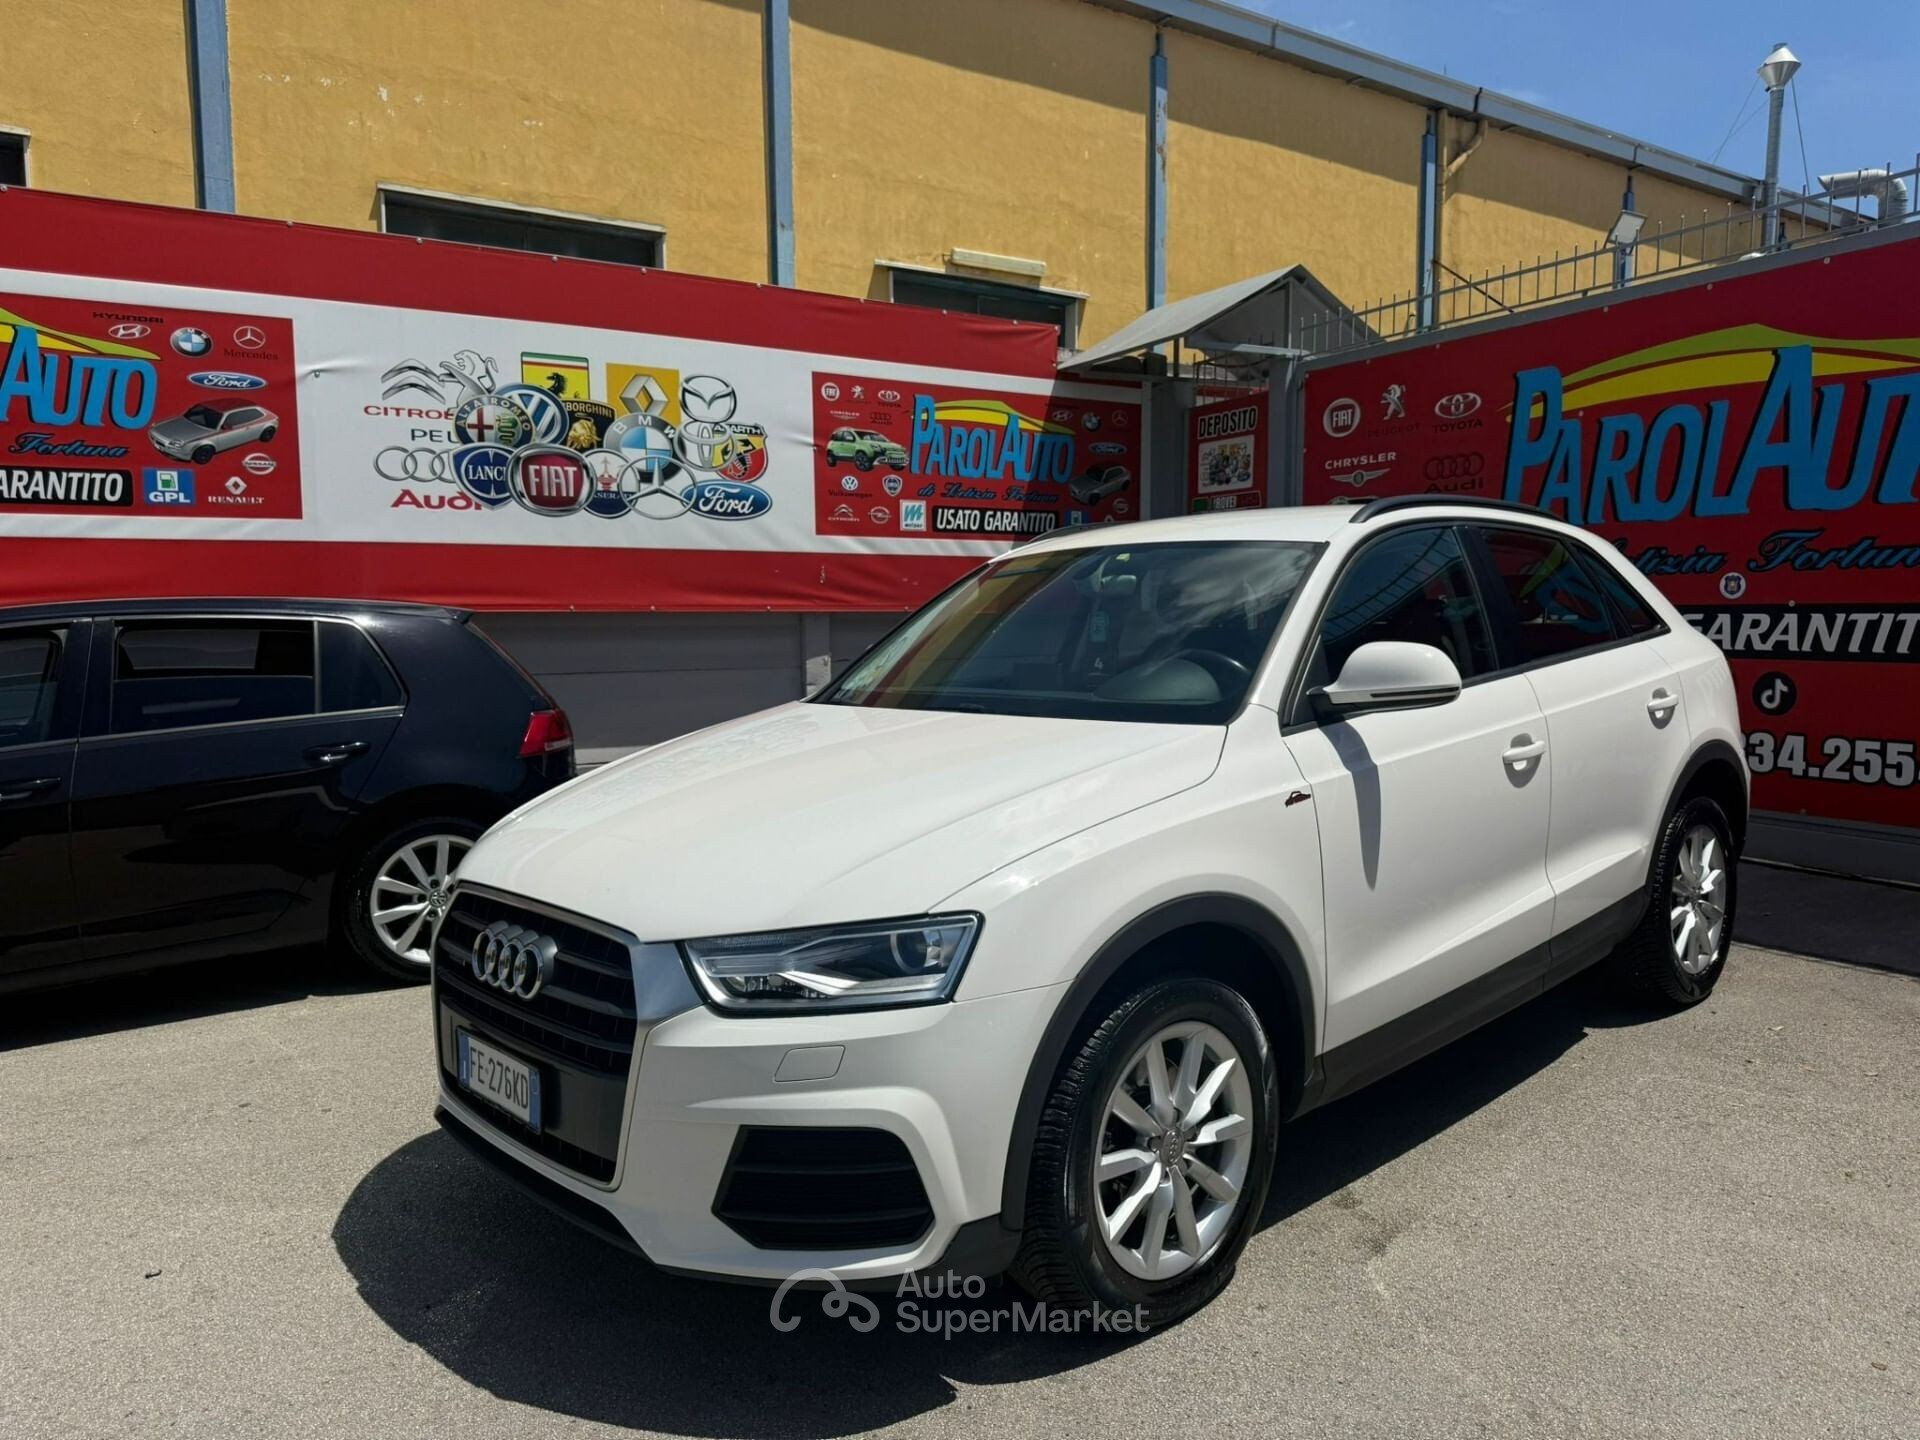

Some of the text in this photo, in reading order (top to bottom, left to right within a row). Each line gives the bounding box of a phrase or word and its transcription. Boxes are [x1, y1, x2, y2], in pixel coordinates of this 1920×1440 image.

[223, 348, 279, 361] Mercedes
[203, 373, 252, 388] Ford
[456, 397, 532, 432] ALFA ROMEO
[564, 400, 613, 418] BORGHINI
[1199, 407, 1257, 437] DEPOSITO
[1332, 409, 1353, 428] FIAT
[1432, 419, 1484, 432] TOYOTA
[9, 432, 131, 458] Fortuna
[1325, 452, 1397, 469] CHRYSLER
[528, 465, 578, 497] FIAT
[1424, 478, 1484, 494] Audi
[148, 491, 191, 504] GPL
[208, 495, 264, 504] RENAULT
[699, 485, 754, 514] Ford
[936, 507, 1056, 534] USATO GARANTITO
[1741, 731, 1920, 786] 34.255
